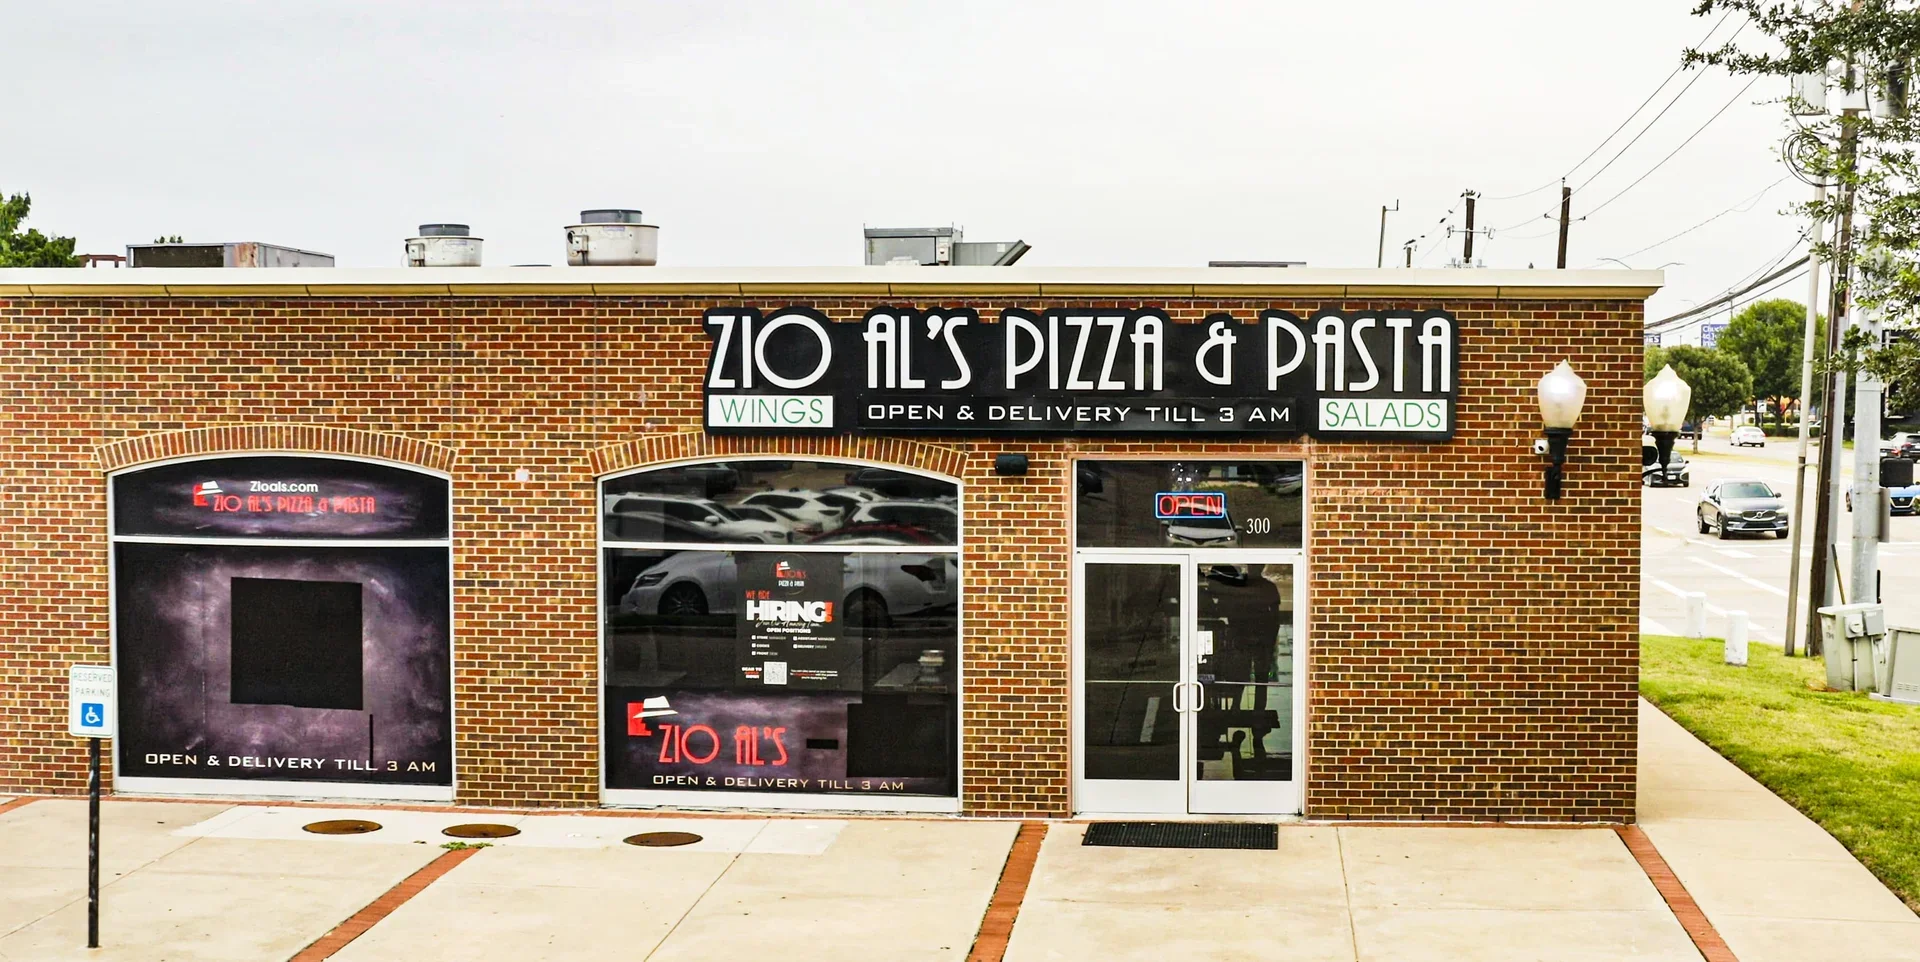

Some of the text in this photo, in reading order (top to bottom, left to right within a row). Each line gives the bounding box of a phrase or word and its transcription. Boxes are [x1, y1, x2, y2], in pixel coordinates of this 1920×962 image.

[708, 314, 1451, 392] ZIO AL'S PIZZA & PASTA
[719, 398, 823, 424] WINGS
[868, 404, 1289, 422] OPEN & DELIVERY TILL 3 AM
[1325, 401, 1441, 428] SALADS
[250, 481, 318, 493] Zioals.com
[213, 496, 242, 512] ZIO
[248, 496, 272, 512] AL'S
[277, 496, 312, 513] PIZZA
[333, 496, 375, 513] PASTA
[1160, 496, 1221, 516] OPEN
[1246, 517, 1271, 534] 300
[746, 600, 833, 622] HIRING!
[73, 672, 112, 682] RESERVED
[75, 687, 110, 698] PARKING
[658, 725, 788, 766] ZIO AL'S
[145, 753, 436, 772] OPEN & DELIVERY TILL 3 AM
[653, 775, 905, 791] OPEN & DELIVERY TILL 3 AM
